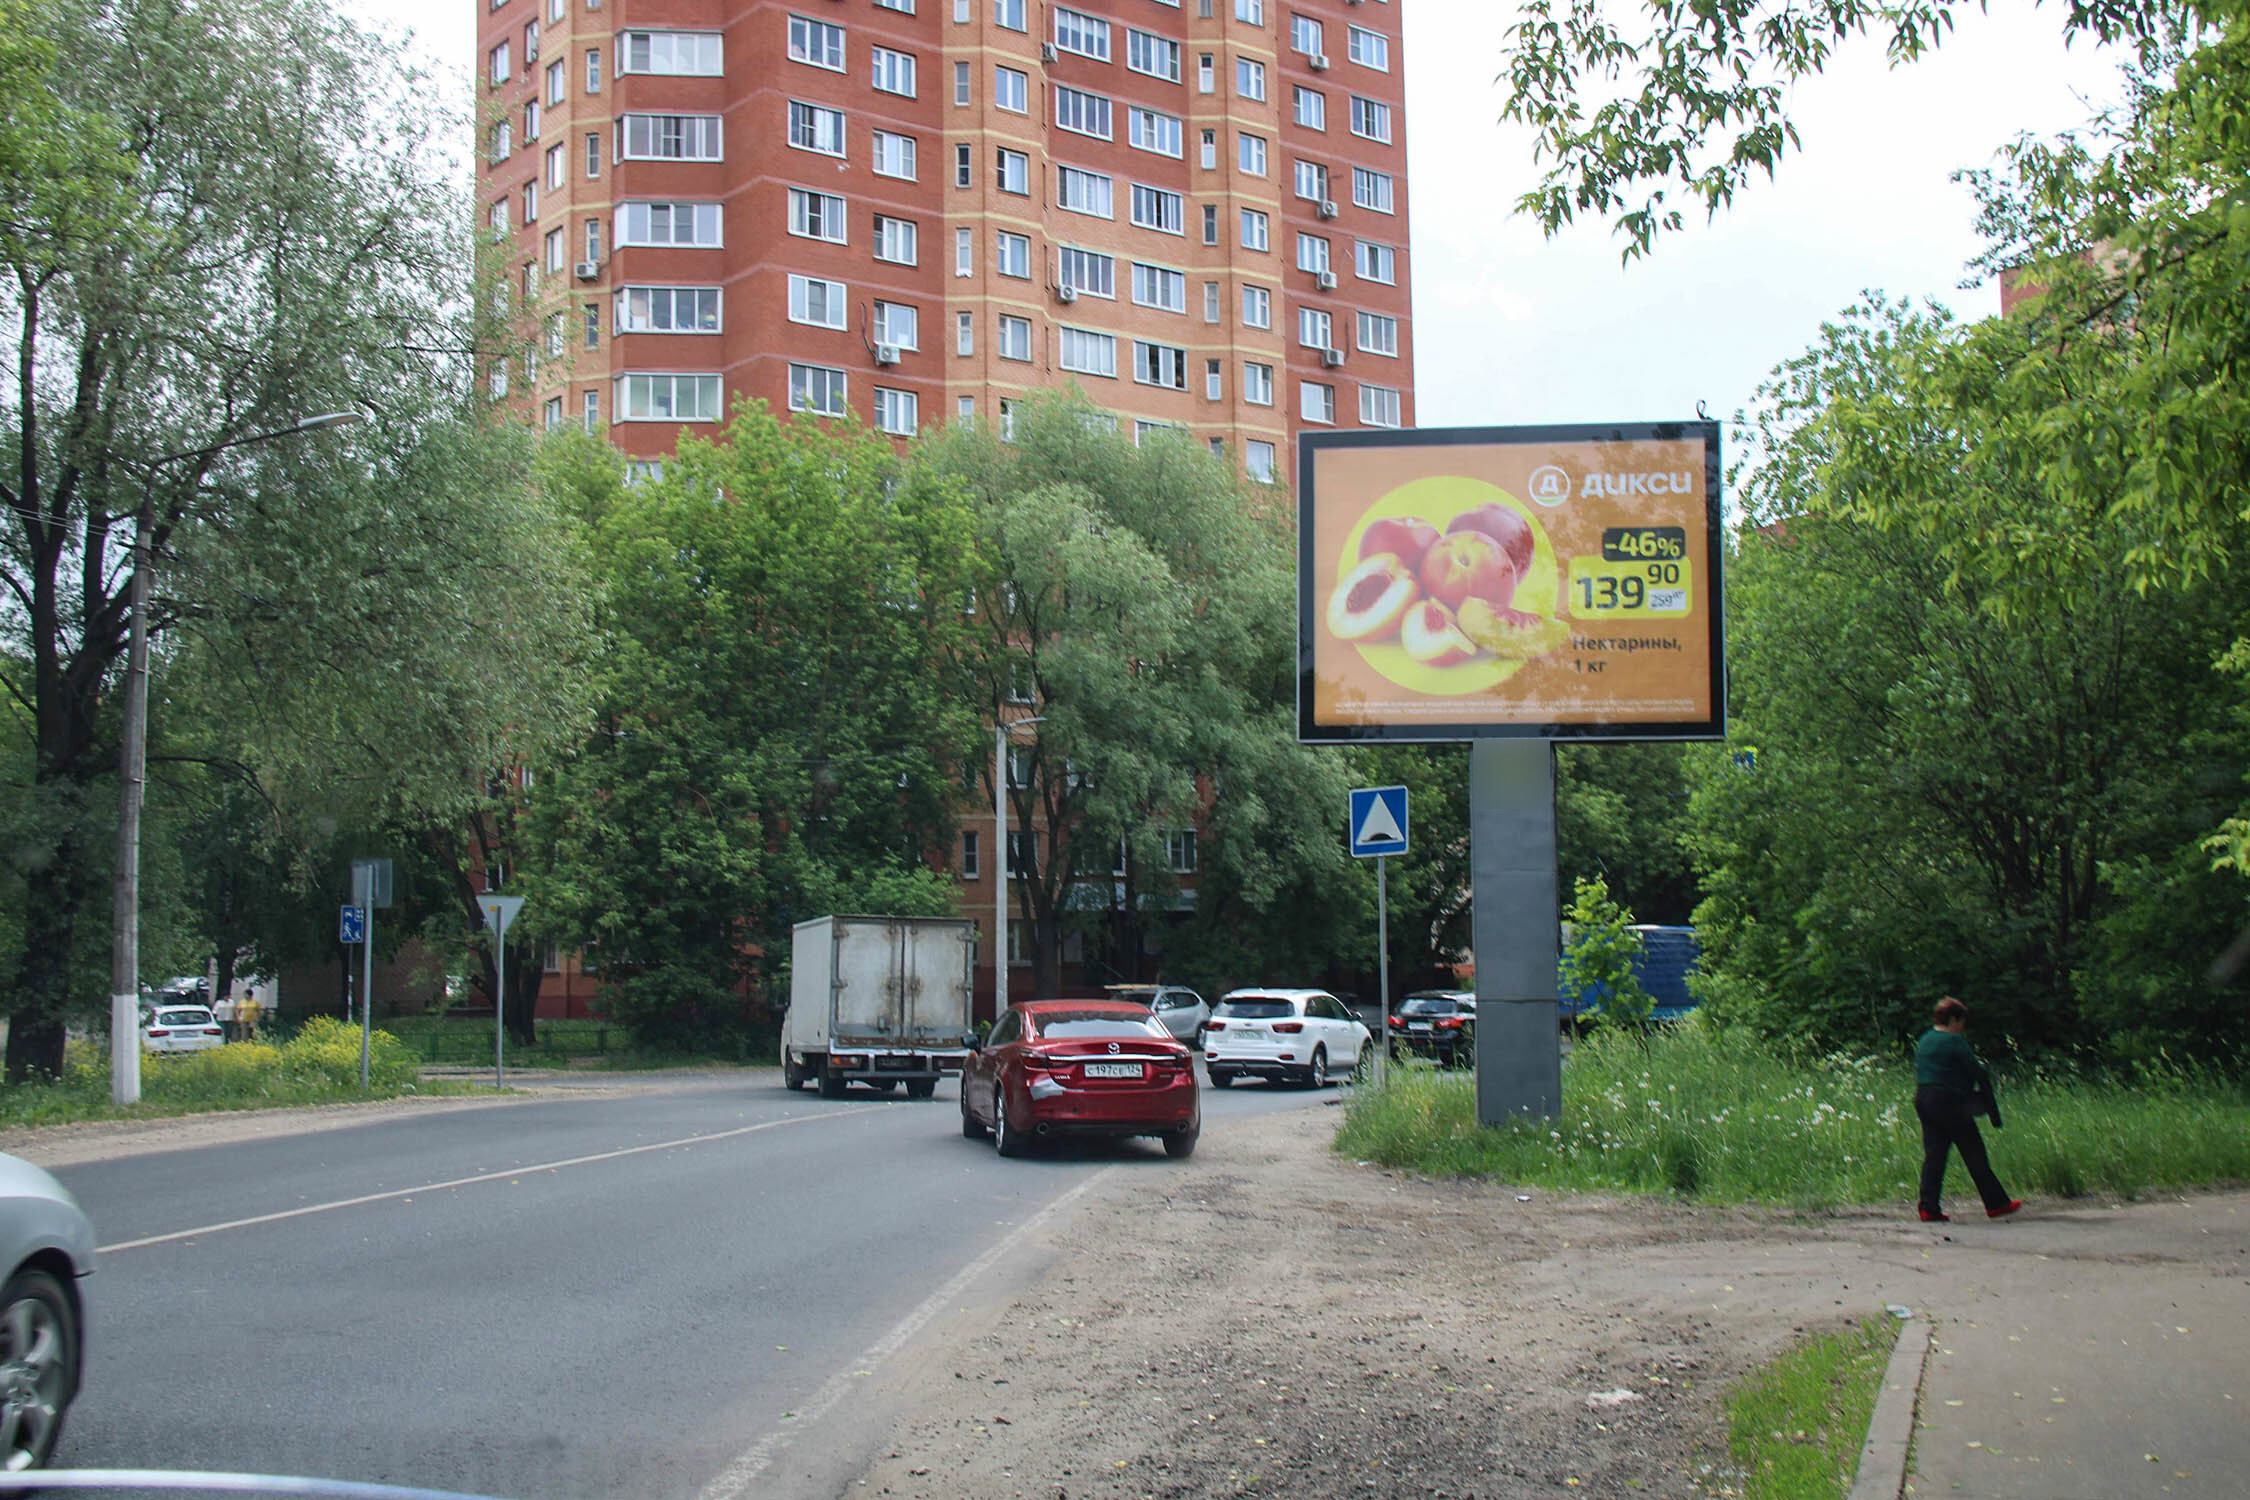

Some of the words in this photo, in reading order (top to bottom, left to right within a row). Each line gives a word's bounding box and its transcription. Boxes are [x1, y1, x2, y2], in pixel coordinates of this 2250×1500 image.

[1604, 531, 1681, 557] -46%
[1576, 575, 1645, 610] 139
[1647, 563, 1680, 584] 90
[1572, 636, 1682, 653] Нектарины,
[1574, 659, 1582, 673] 1
[1587, 661, 1608, 672] кг
